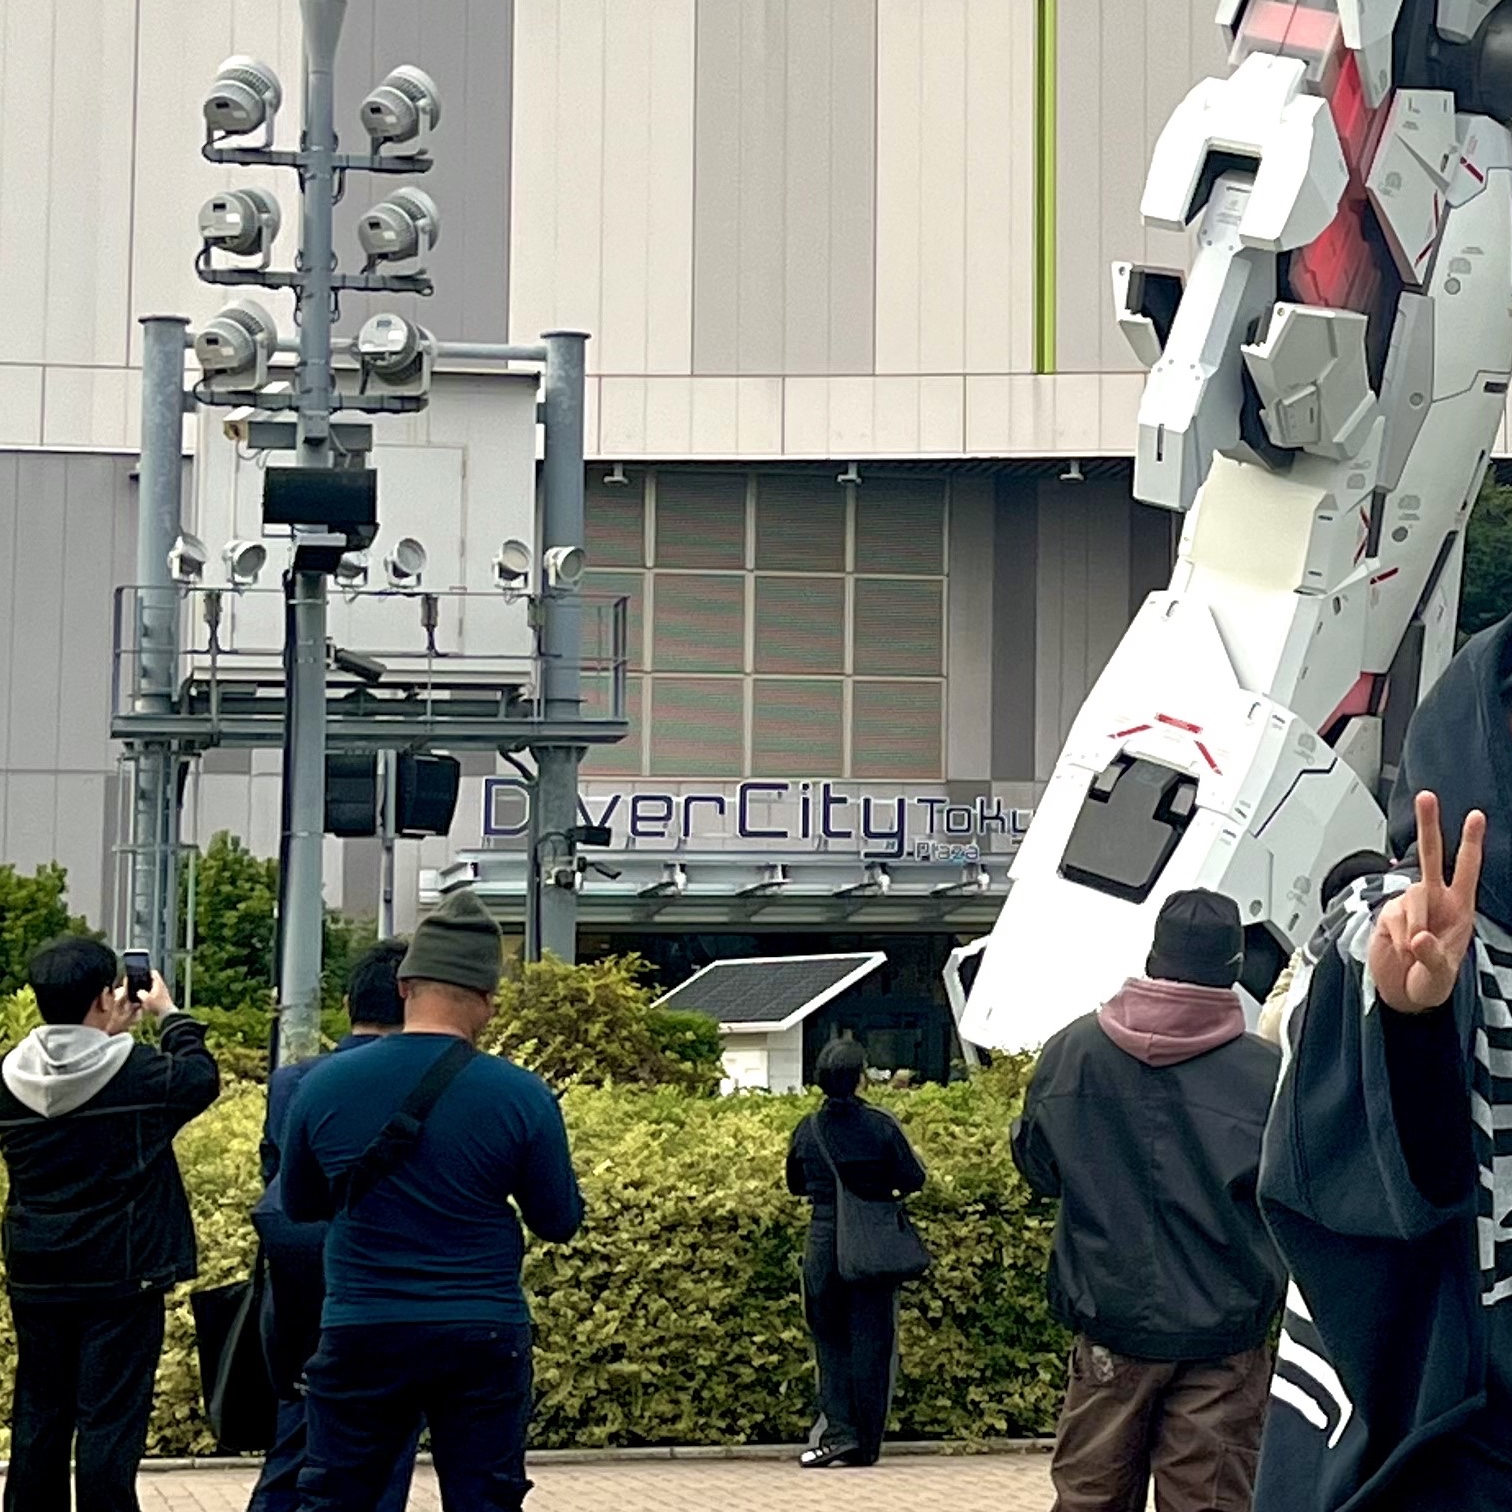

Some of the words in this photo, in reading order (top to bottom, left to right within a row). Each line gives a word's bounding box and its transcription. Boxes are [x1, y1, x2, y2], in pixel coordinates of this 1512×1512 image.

[483, 777, 907, 860] DverCity
[916, 797, 1036, 846] Toky
[915, 841, 981, 862] Plaza
